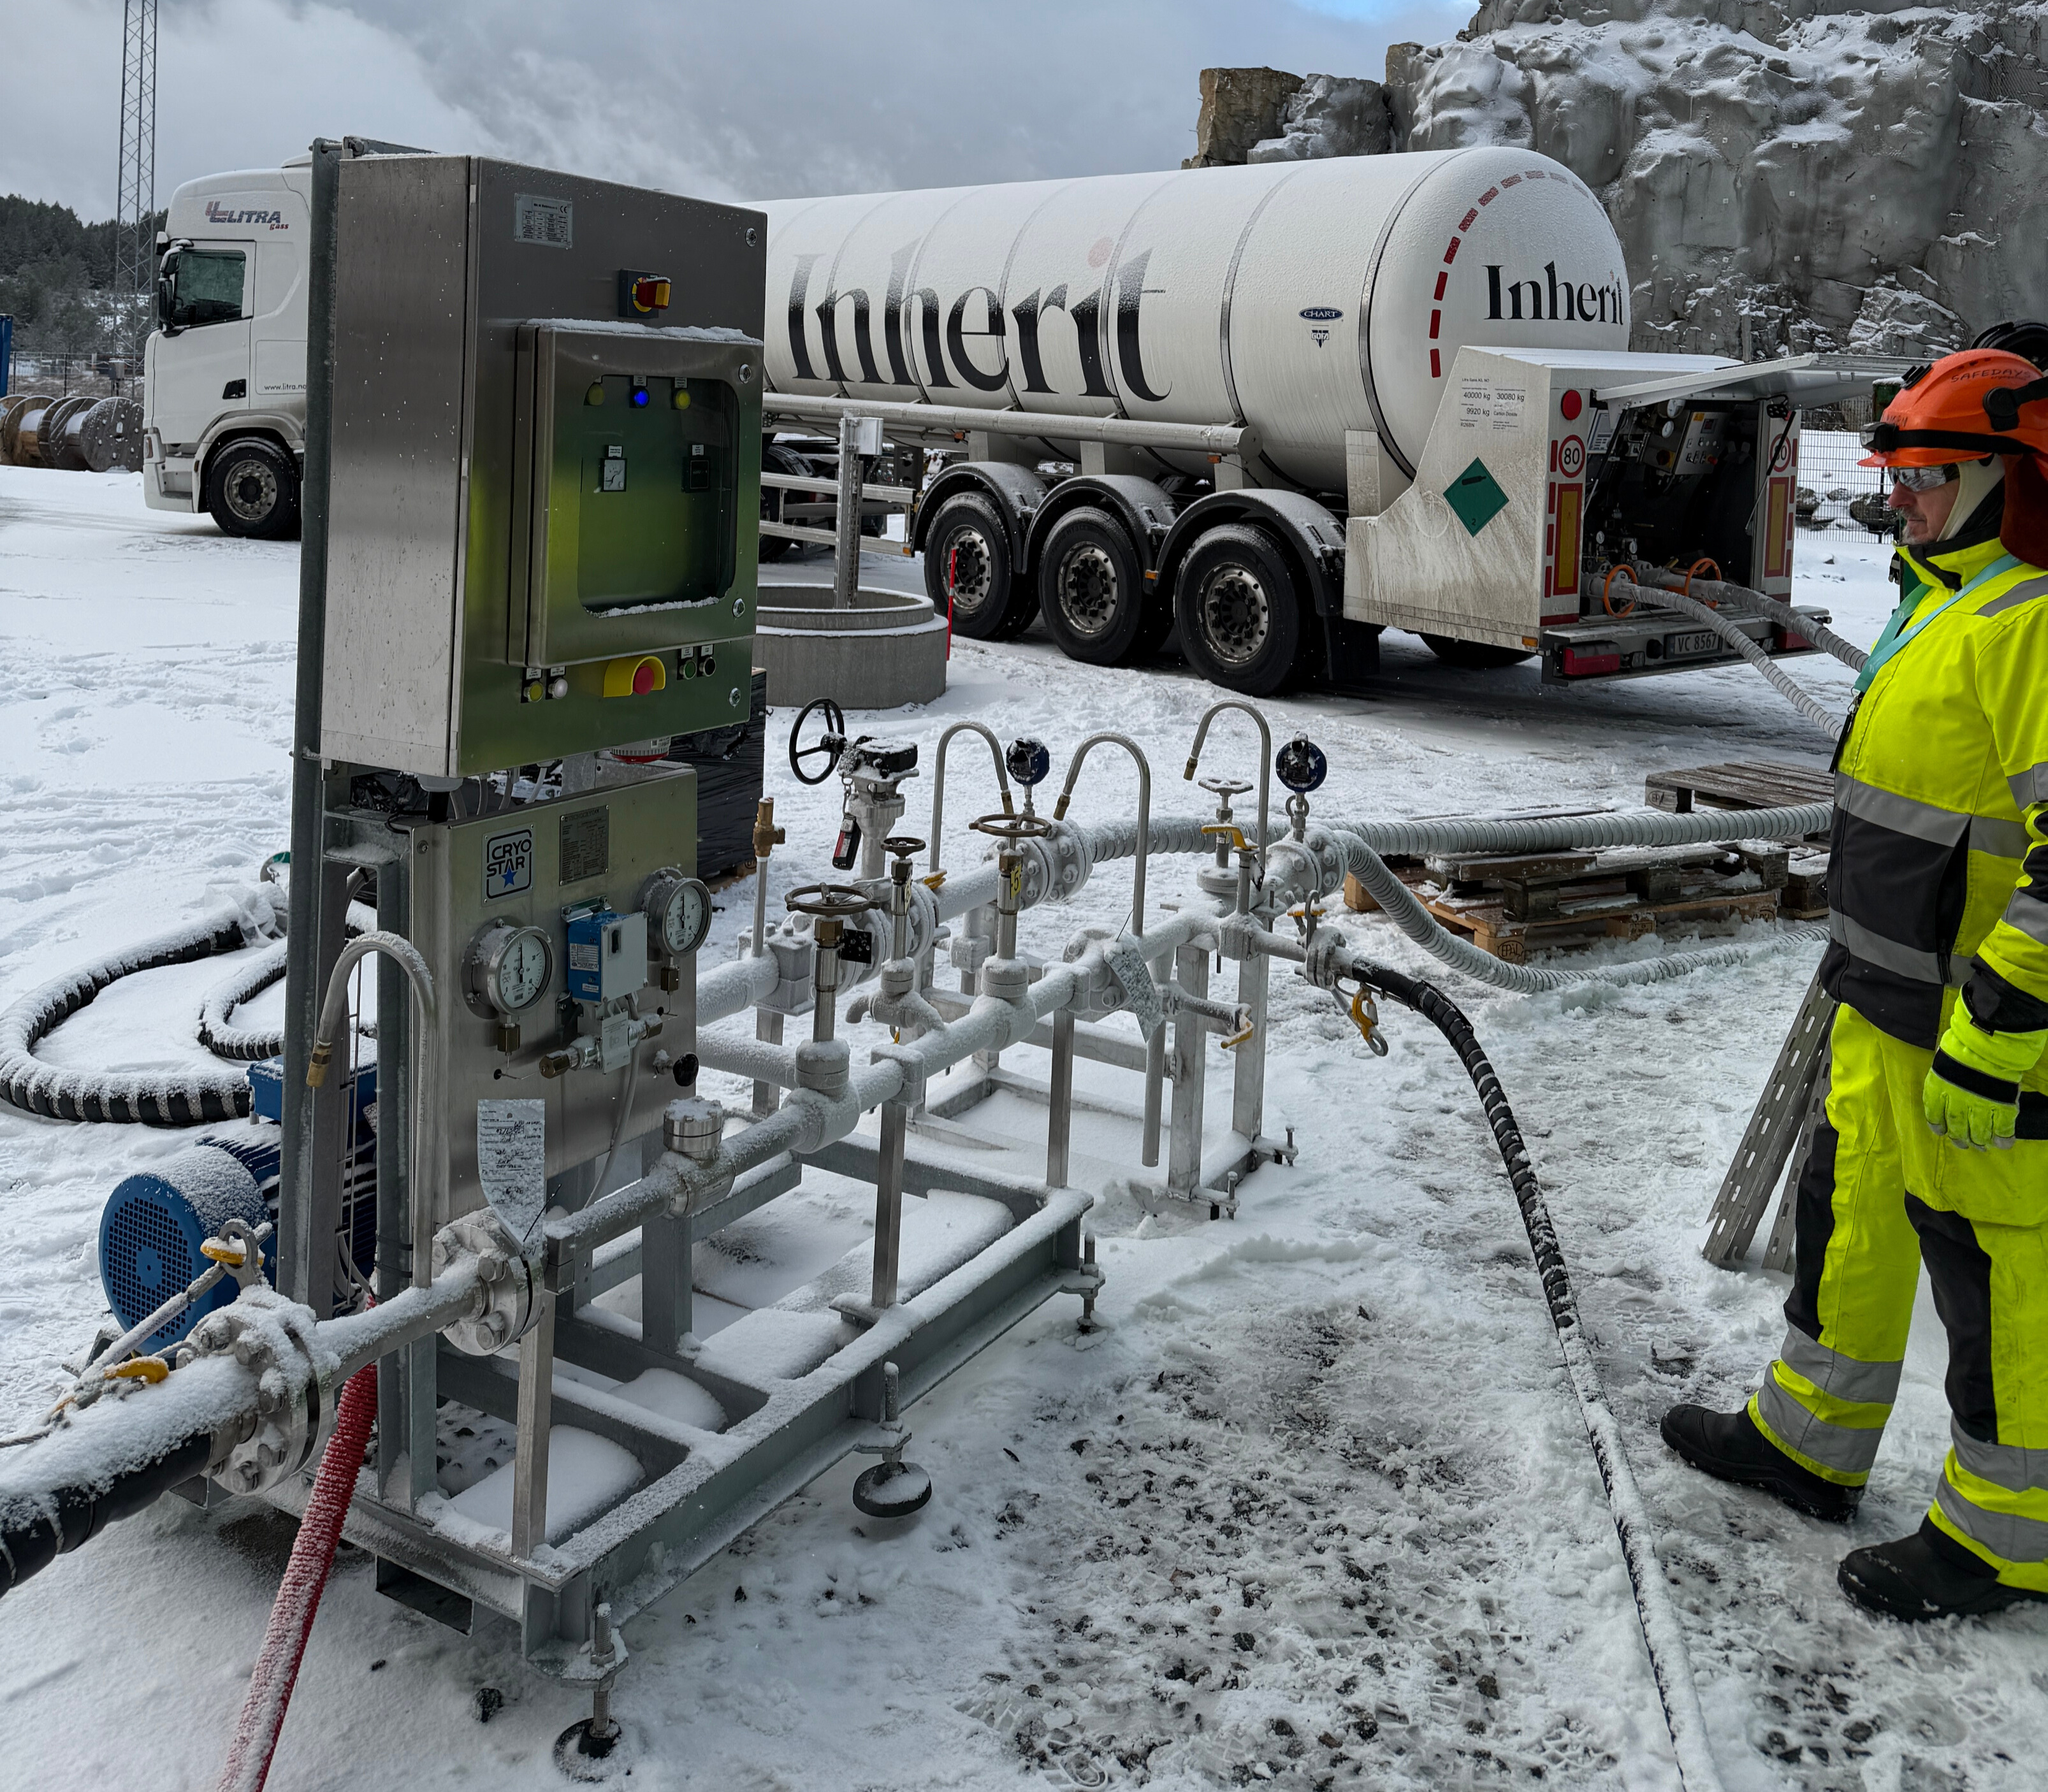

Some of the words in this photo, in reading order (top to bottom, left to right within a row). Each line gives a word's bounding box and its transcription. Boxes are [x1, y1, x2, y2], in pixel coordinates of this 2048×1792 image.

[1481, 260, 1624, 326] Inherit
[788, 237, 1173, 403] Inherit
[1311, 332, 1330, 340] GOFA
[264, 382, 307, 391] www.litra.no
[1483, 393, 1491, 401] kg
[1517, 394, 1525, 403] kg
[1466, 407, 1481, 415] 9920
[1483, 408, 1490, 417] kg
[1564, 447, 1580, 465] 80
[1471, 518, 1476, 526] 2
[1678, 636, 1690, 653] VC
[1694, 633, 1717, 650] 8567
[491, 839, 532, 860] CRYO
[486, 855, 525, 878] STAR
[1014, 869, 1019, 892] 5
